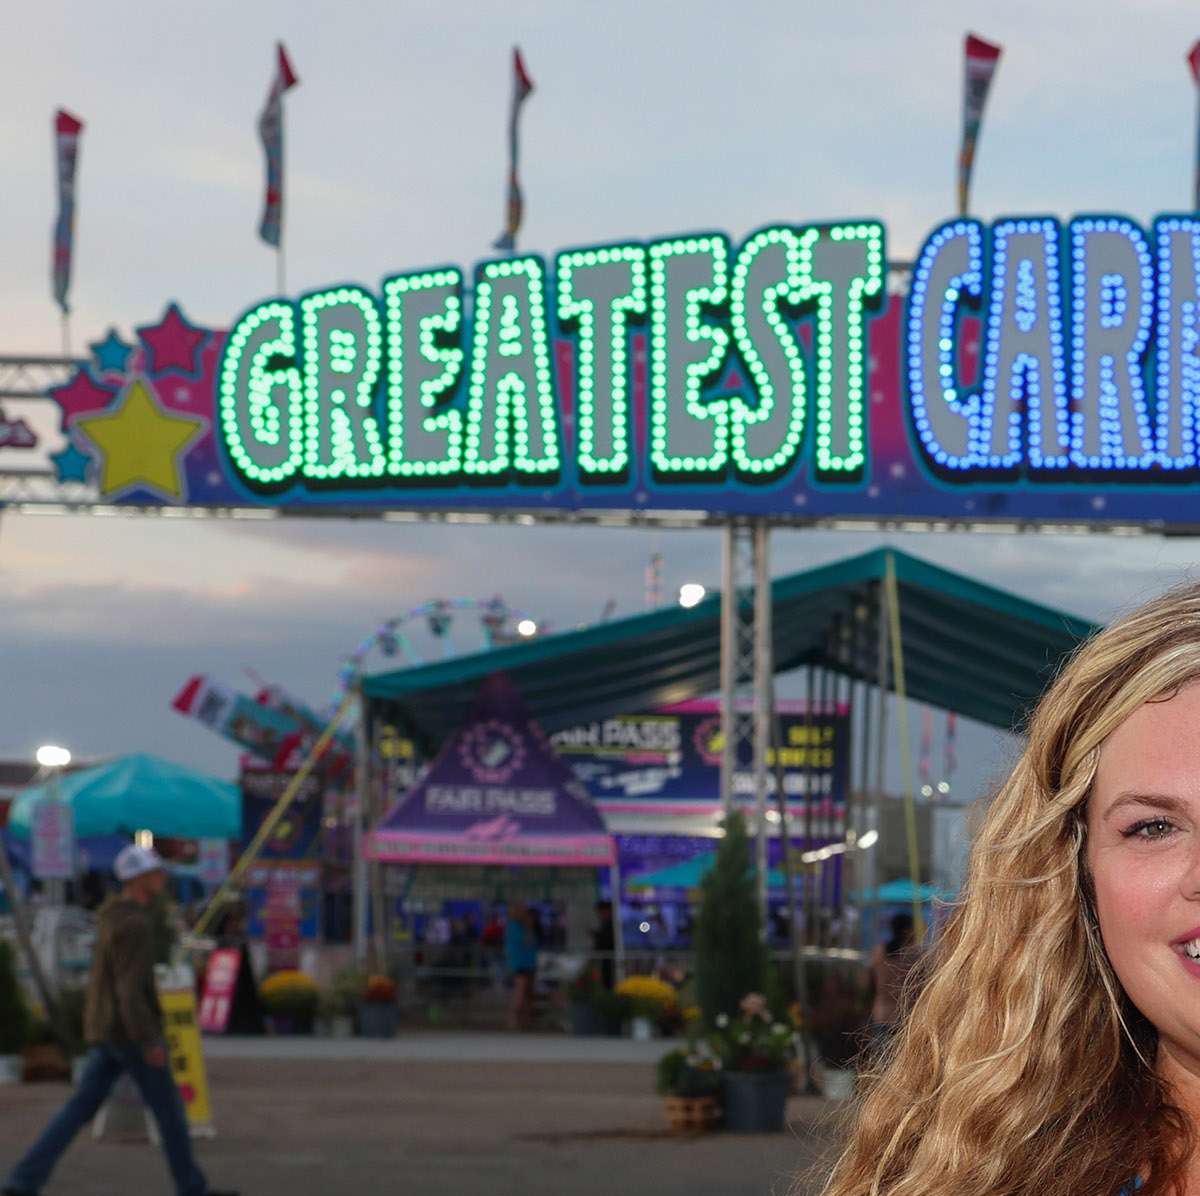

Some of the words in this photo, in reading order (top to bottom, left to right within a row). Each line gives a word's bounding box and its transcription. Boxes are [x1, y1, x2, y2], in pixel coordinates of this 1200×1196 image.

[220, 223, 885, 482] GREATEST
[602, 717, 682, 751] PASS
[424, 784, 482, 813] FAIR
[486, 784, 556, 815] PASS
